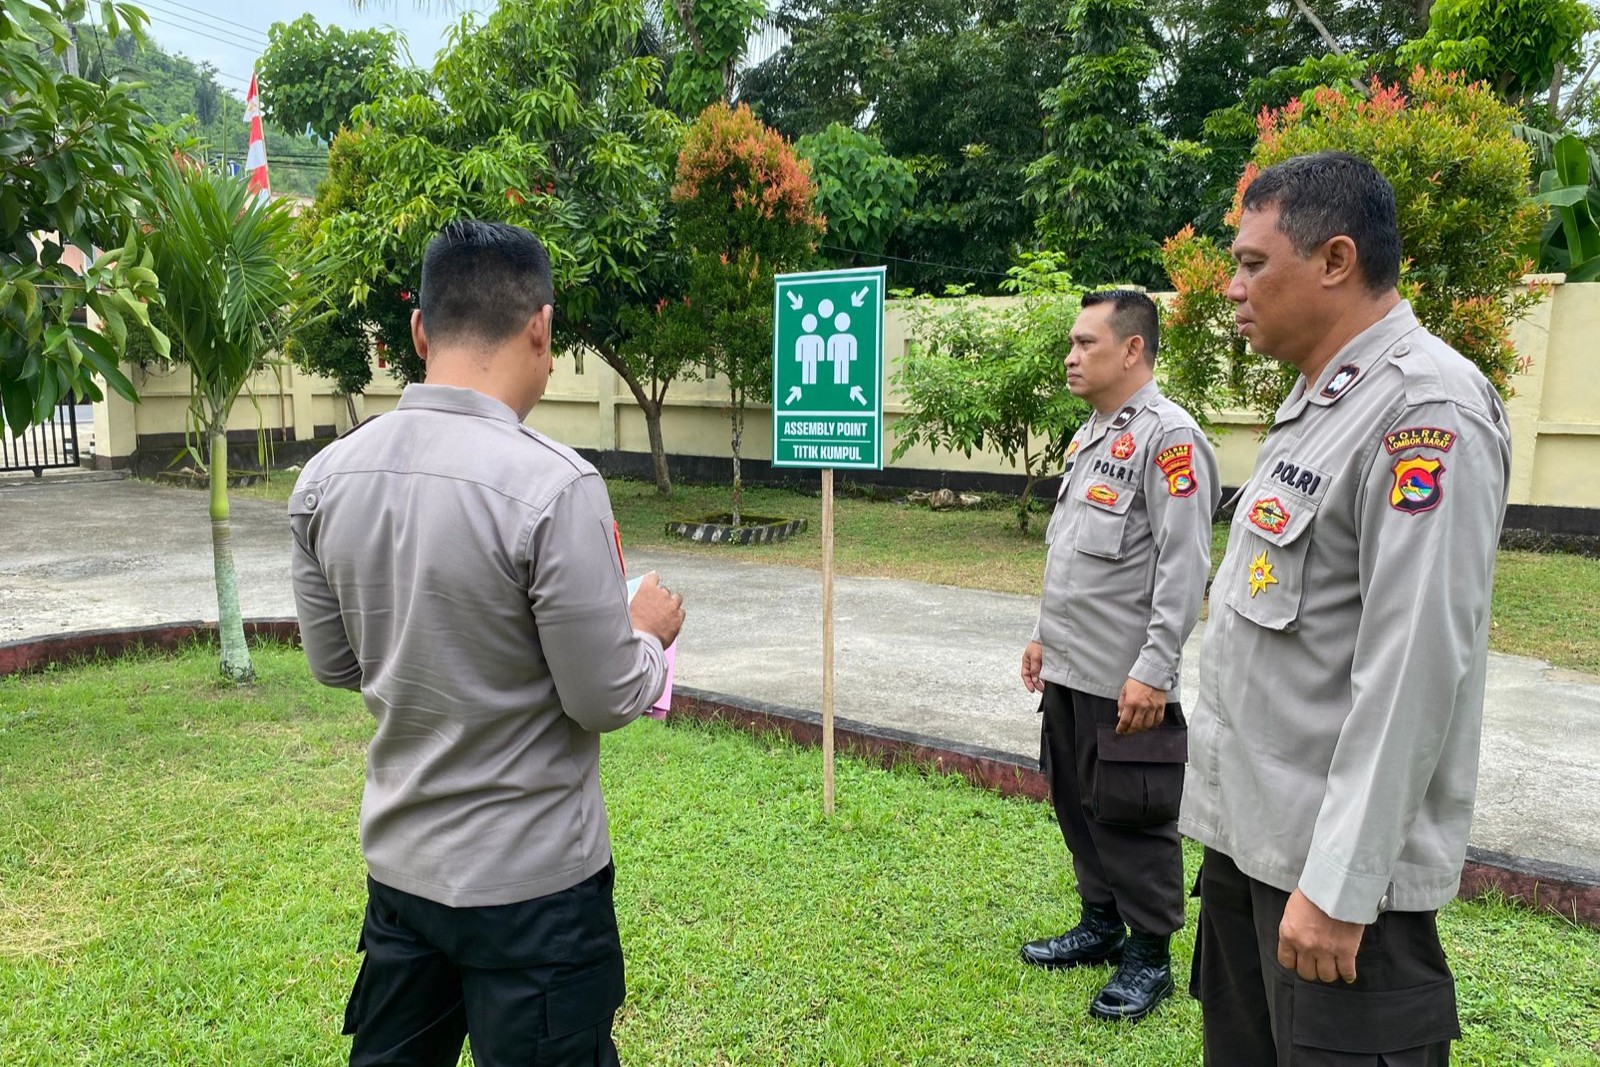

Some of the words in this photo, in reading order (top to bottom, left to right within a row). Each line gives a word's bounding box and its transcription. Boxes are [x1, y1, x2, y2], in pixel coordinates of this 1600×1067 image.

[784, 421, 835, 436] ASSEMBLY
[837, 422, 867, 437] POINT
[1388, 429, 1451, 444] POLRES
[793, 444, 818, 459] TITIK
[820, 446, 861, 460] KUMPUL
[1389, 438, 1421, 451] LOMBOK
[1423, 437, 1449, 448] BARAT
[1093, 459, 1133, 481] POLRI
[1271, 460, 1321, 495] POLRI
